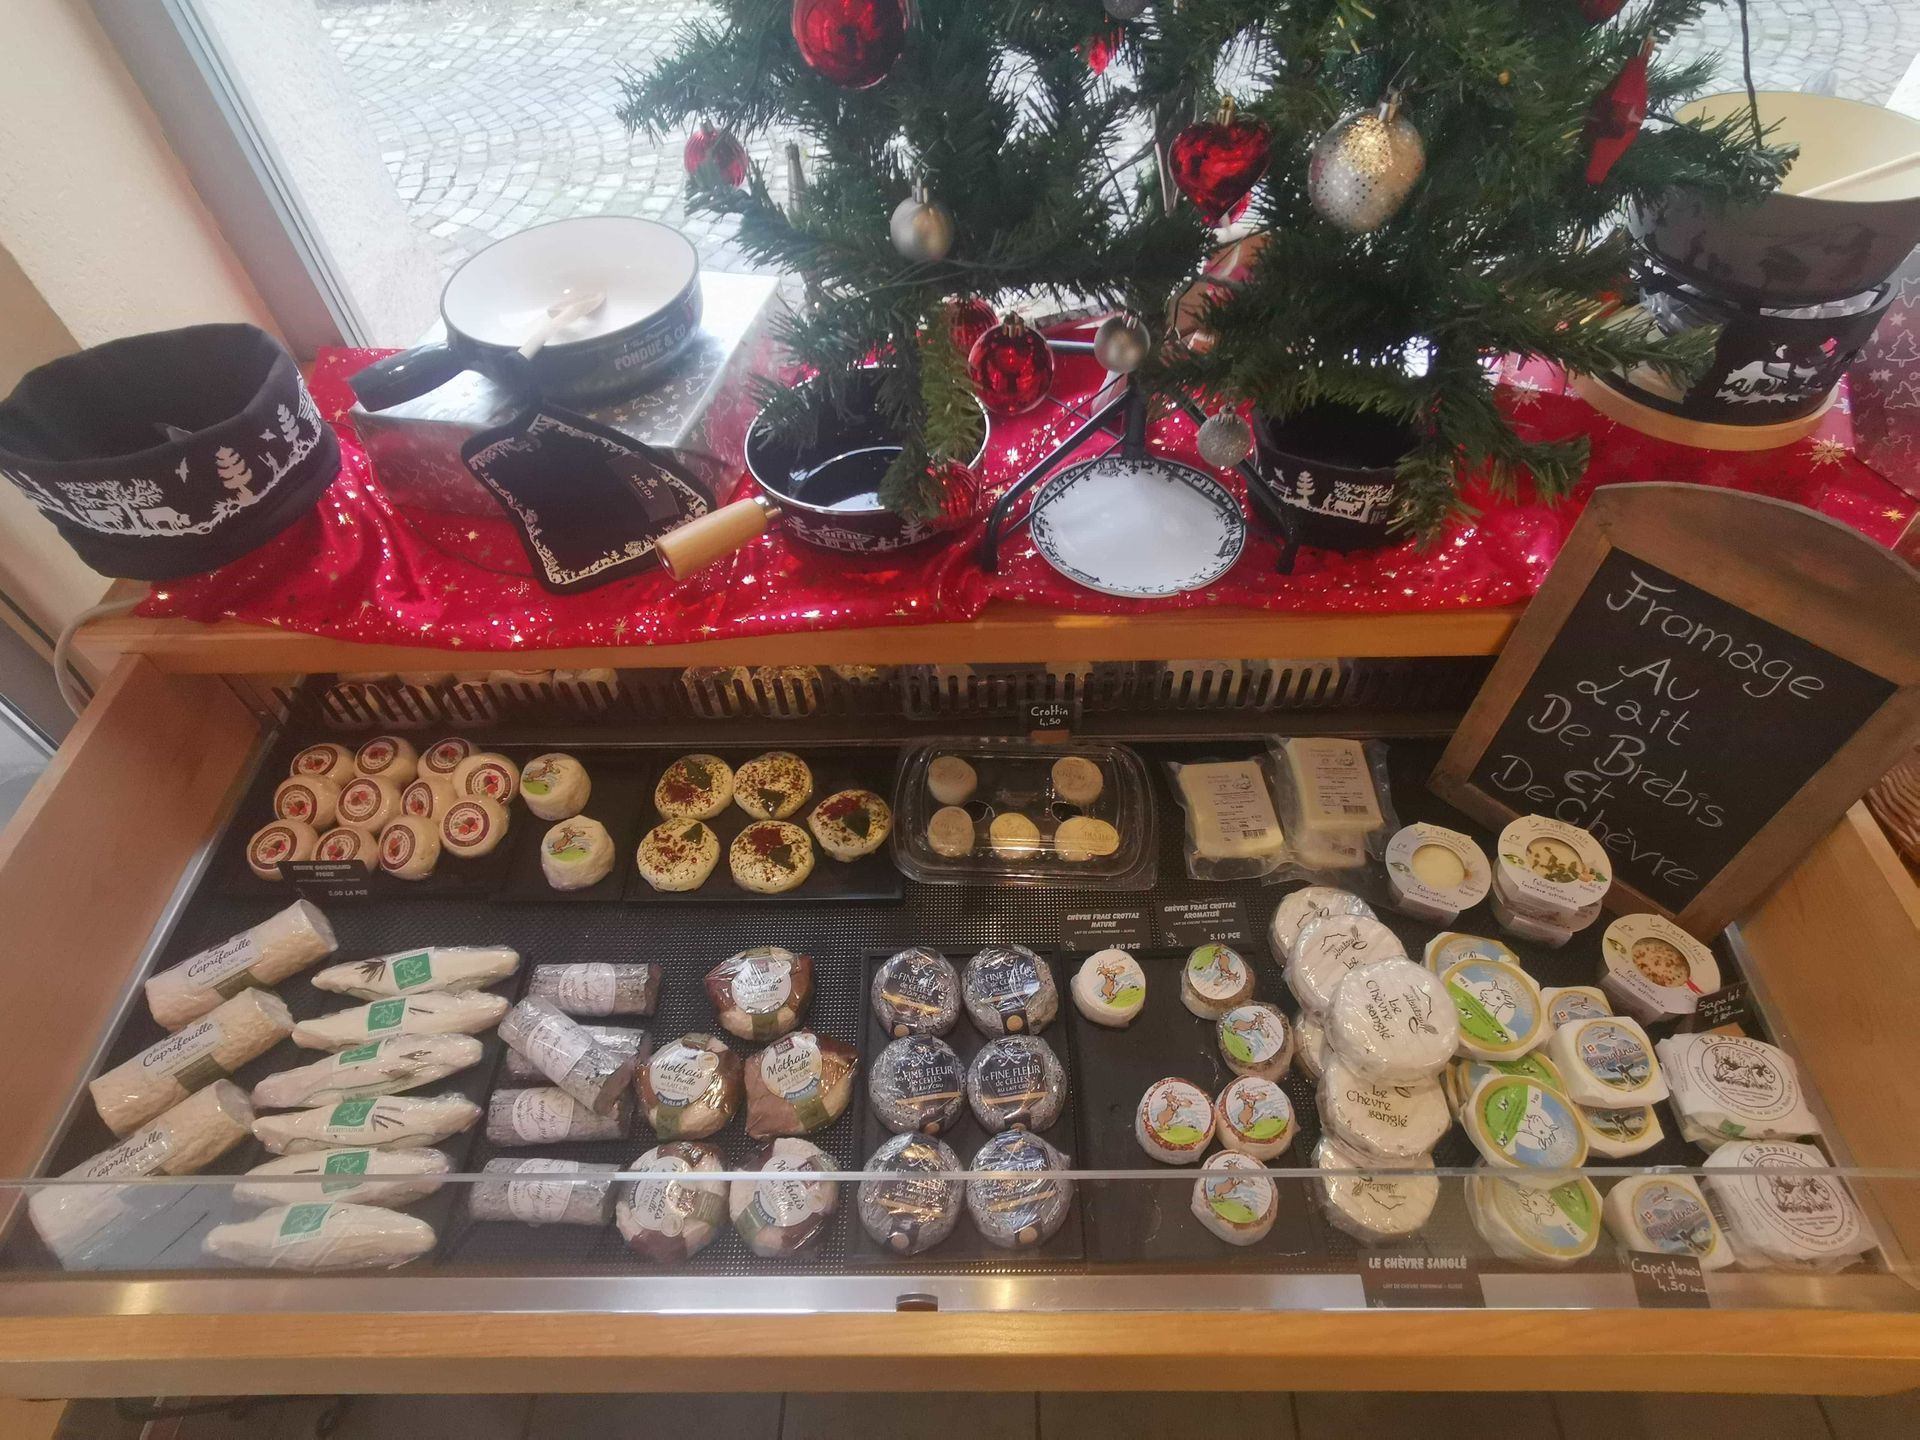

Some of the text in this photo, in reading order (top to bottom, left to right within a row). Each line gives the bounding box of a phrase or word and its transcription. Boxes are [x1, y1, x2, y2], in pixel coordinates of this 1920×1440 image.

[632, 474, 655, 499] HEIDI
[1605, 570, 1825, 699] Fromage
[1619, 658, 1700, 701] Au
[1030, 704, 1069, 717] Crottin
[1527, 693, 1591, 746] De
[1577, 680, 1691, 745] Lait
[1490, 755, 1556, 801] De
[1564, 770, 1615, 803] Et
[1594, 734, 1725, 828] Brebis
[1092, 912, 1112, 920] FRAIS
[1189, 903, 1209, 911] FRAIS
[1227, 931, 1241, 939] PCE
[187, 938, 251, 978] Caprifeuille
[898, 972, 917, 985] FINE
[985, 971, 1005, 982] FINE
[142, 1021, 214, 1068] Caprifeuille
[656, 1060, 702, 1079] Mothais
[766, 1049, 812, 1079] Mothais
[926, 1065, 954, 1077] FLEUR
[990, 1069, 1010, 1081] FINE
[1012, 1065, 1041, 1077] FLEUR
[1346, 1089, 1392, 1111] Chèvre
[1367, 1109, 1408, 1127] sanglé
[1368, 1254, 1467, 1270] LE CHÈVRE SANGLÉ
